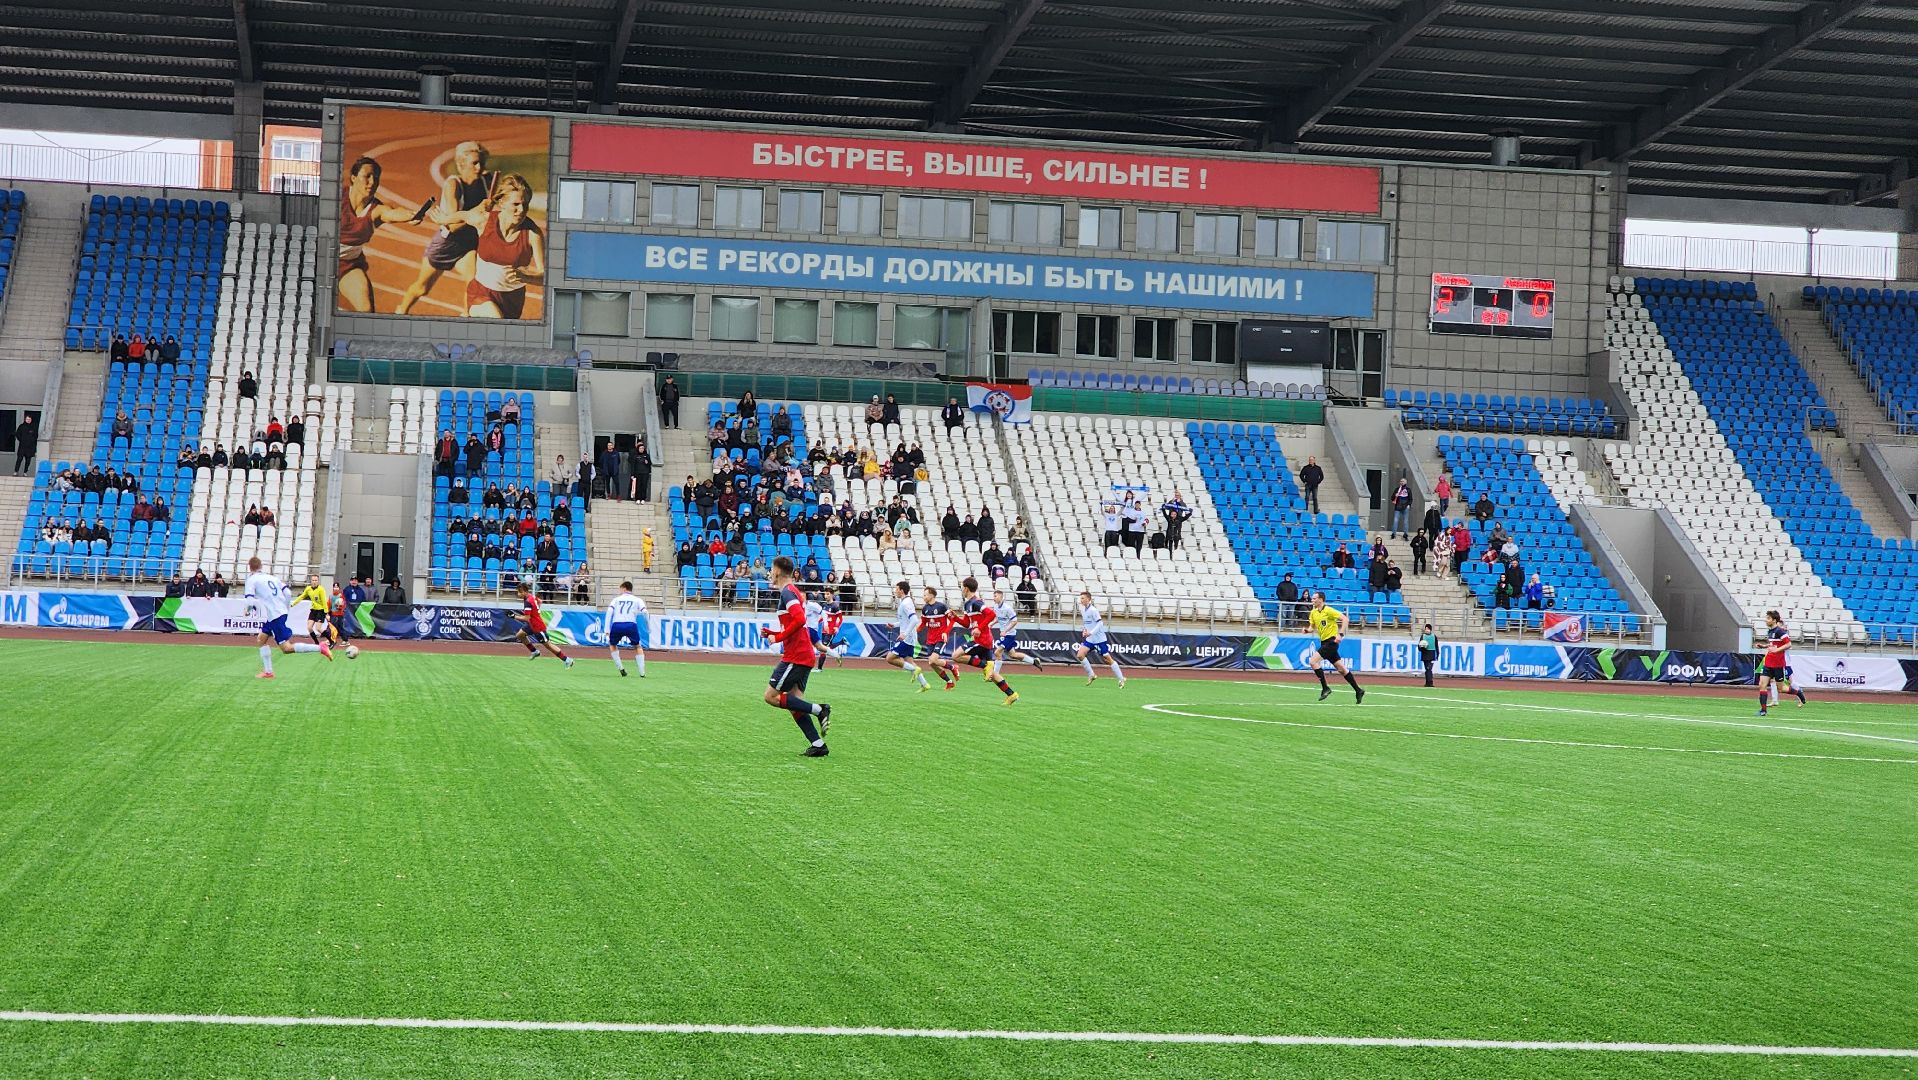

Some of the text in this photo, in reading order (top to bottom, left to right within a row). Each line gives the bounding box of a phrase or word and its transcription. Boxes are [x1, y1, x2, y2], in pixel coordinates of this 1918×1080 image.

[752, 142, 913, 177] БЫСТРЕЕ,
[924, 151, 1033, 185] ВЫШЕ,
[1043, 159, 1190, 189] СИЛЬНЕЕ
[645, 245, 708, 270] ВСЕ
[718, 249, 874, 281] РЕКОРДЫ
[883, 257, 1034, 286] ДОЛЖНЫ
[1044, 266, 1134, 292] БЫТЬ
[1144, 271, 1285, 300] НАШИМИ
[1437, 288, 1453, 313] 2
[1533, 294, 1549, 317] 0
[268, 581, 278, 596] 9
[0, 594, 28, 622] М
[440, 609, 491, 619] РОССИЙСКИЙ
[618, 600, 634, 614] 77
[66, 613, 110, 627] ГАЗПРОМ
[223, 618, 266, 630] Наслед
[440, 618, 493, 628] ФУТБОЛЬНЫЙ
[440, 626, 461, 634] СОЮЗ
[660, 618, 770, 650] ГАЗПРОМ
[992, 639, 1070, 652] ЮОШЕСКАЯ
[1151, 644, 1182, 656] ЛИГА
[1196, 646, 1235, 658] ЦЕНТР
[1371, 642, 1475, 673] ГАЗПОМ
[1510, 663, 1549, 677] ГАЗПРОМ
